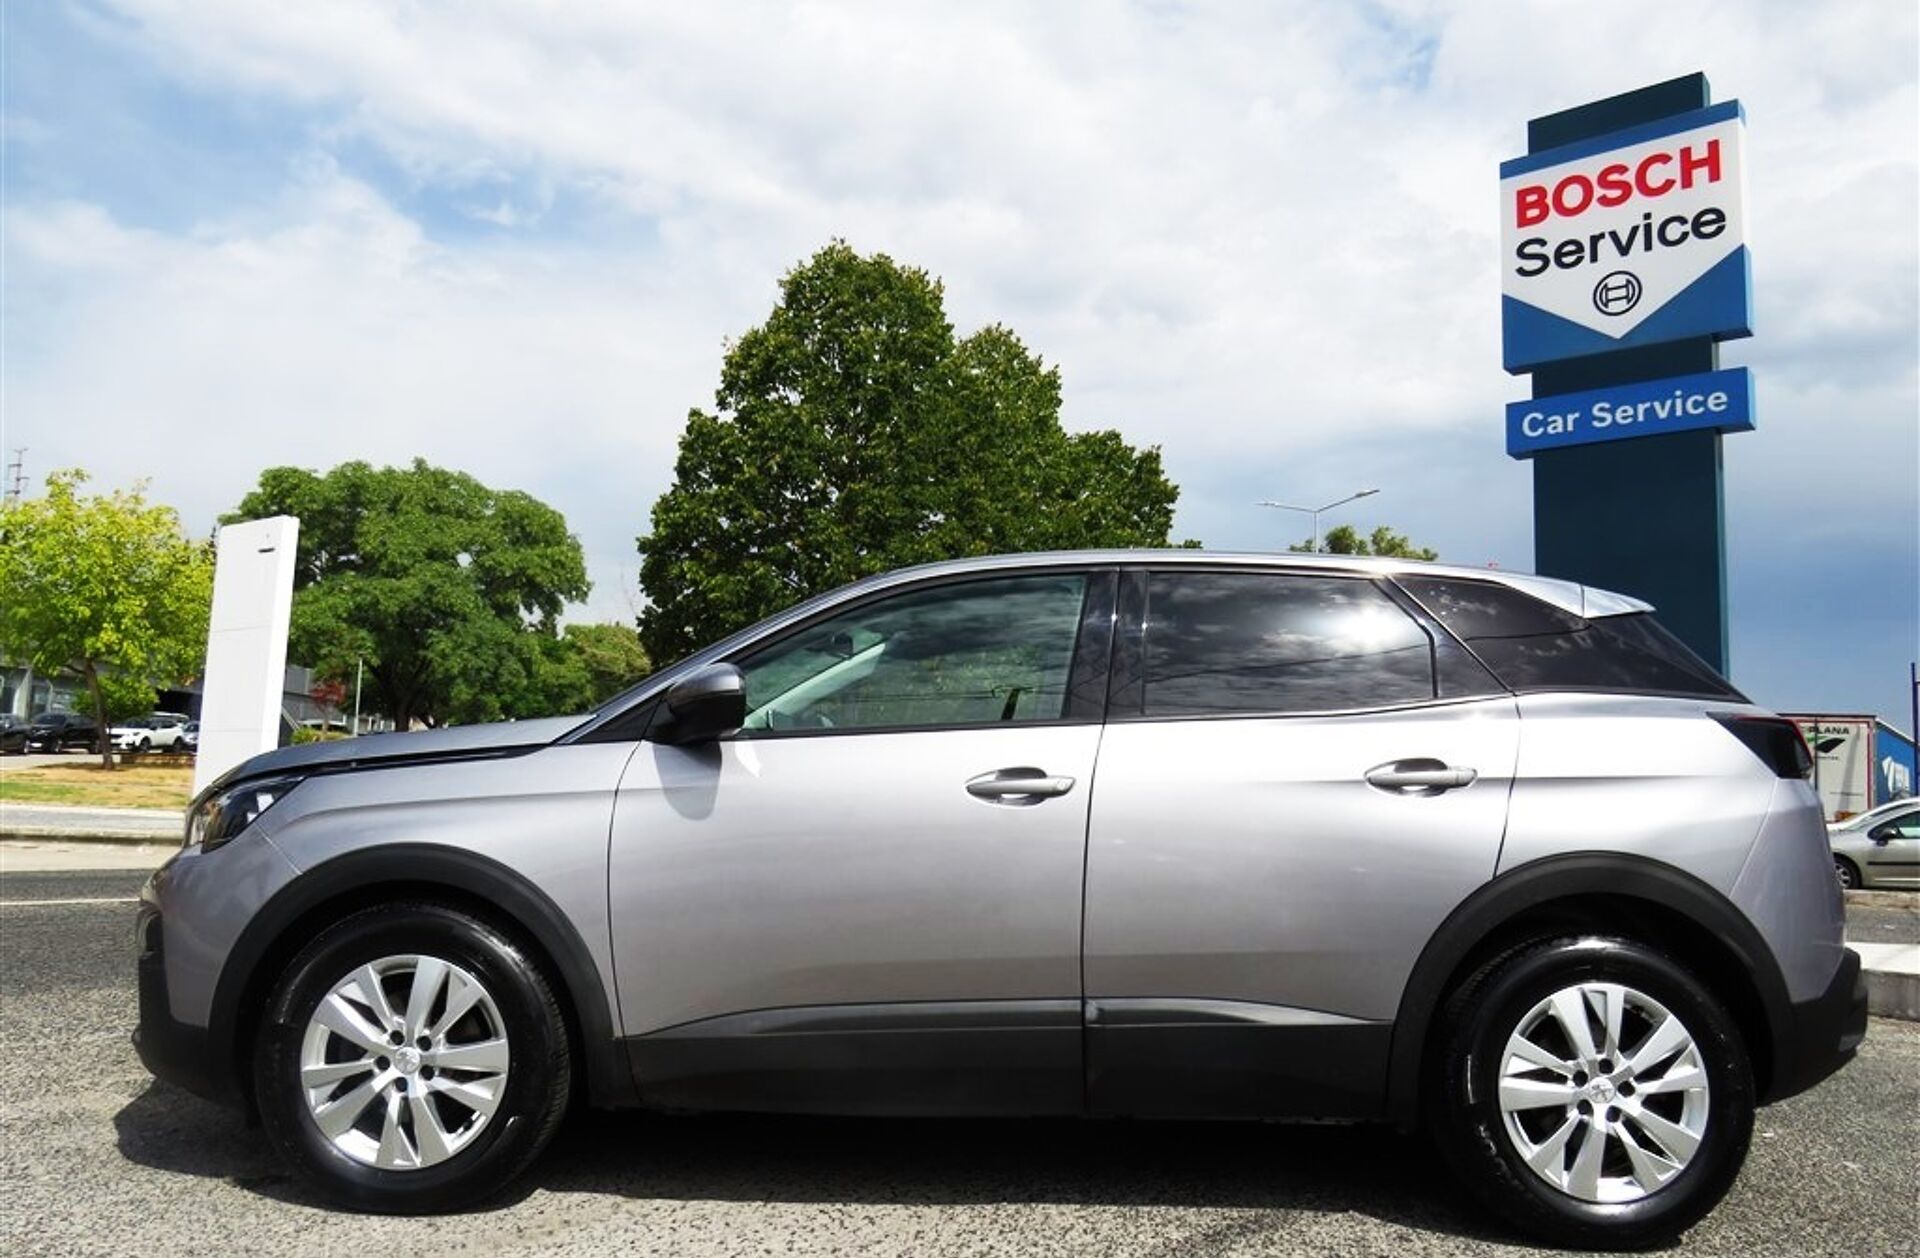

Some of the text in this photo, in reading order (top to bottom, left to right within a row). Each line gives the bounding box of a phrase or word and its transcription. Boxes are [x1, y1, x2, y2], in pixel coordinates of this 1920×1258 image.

[1516, 139, 1721, 228] BOSCH
[1515, 207, 1726, 277] Service
[1522, 390, 1728, 437] Car Service
